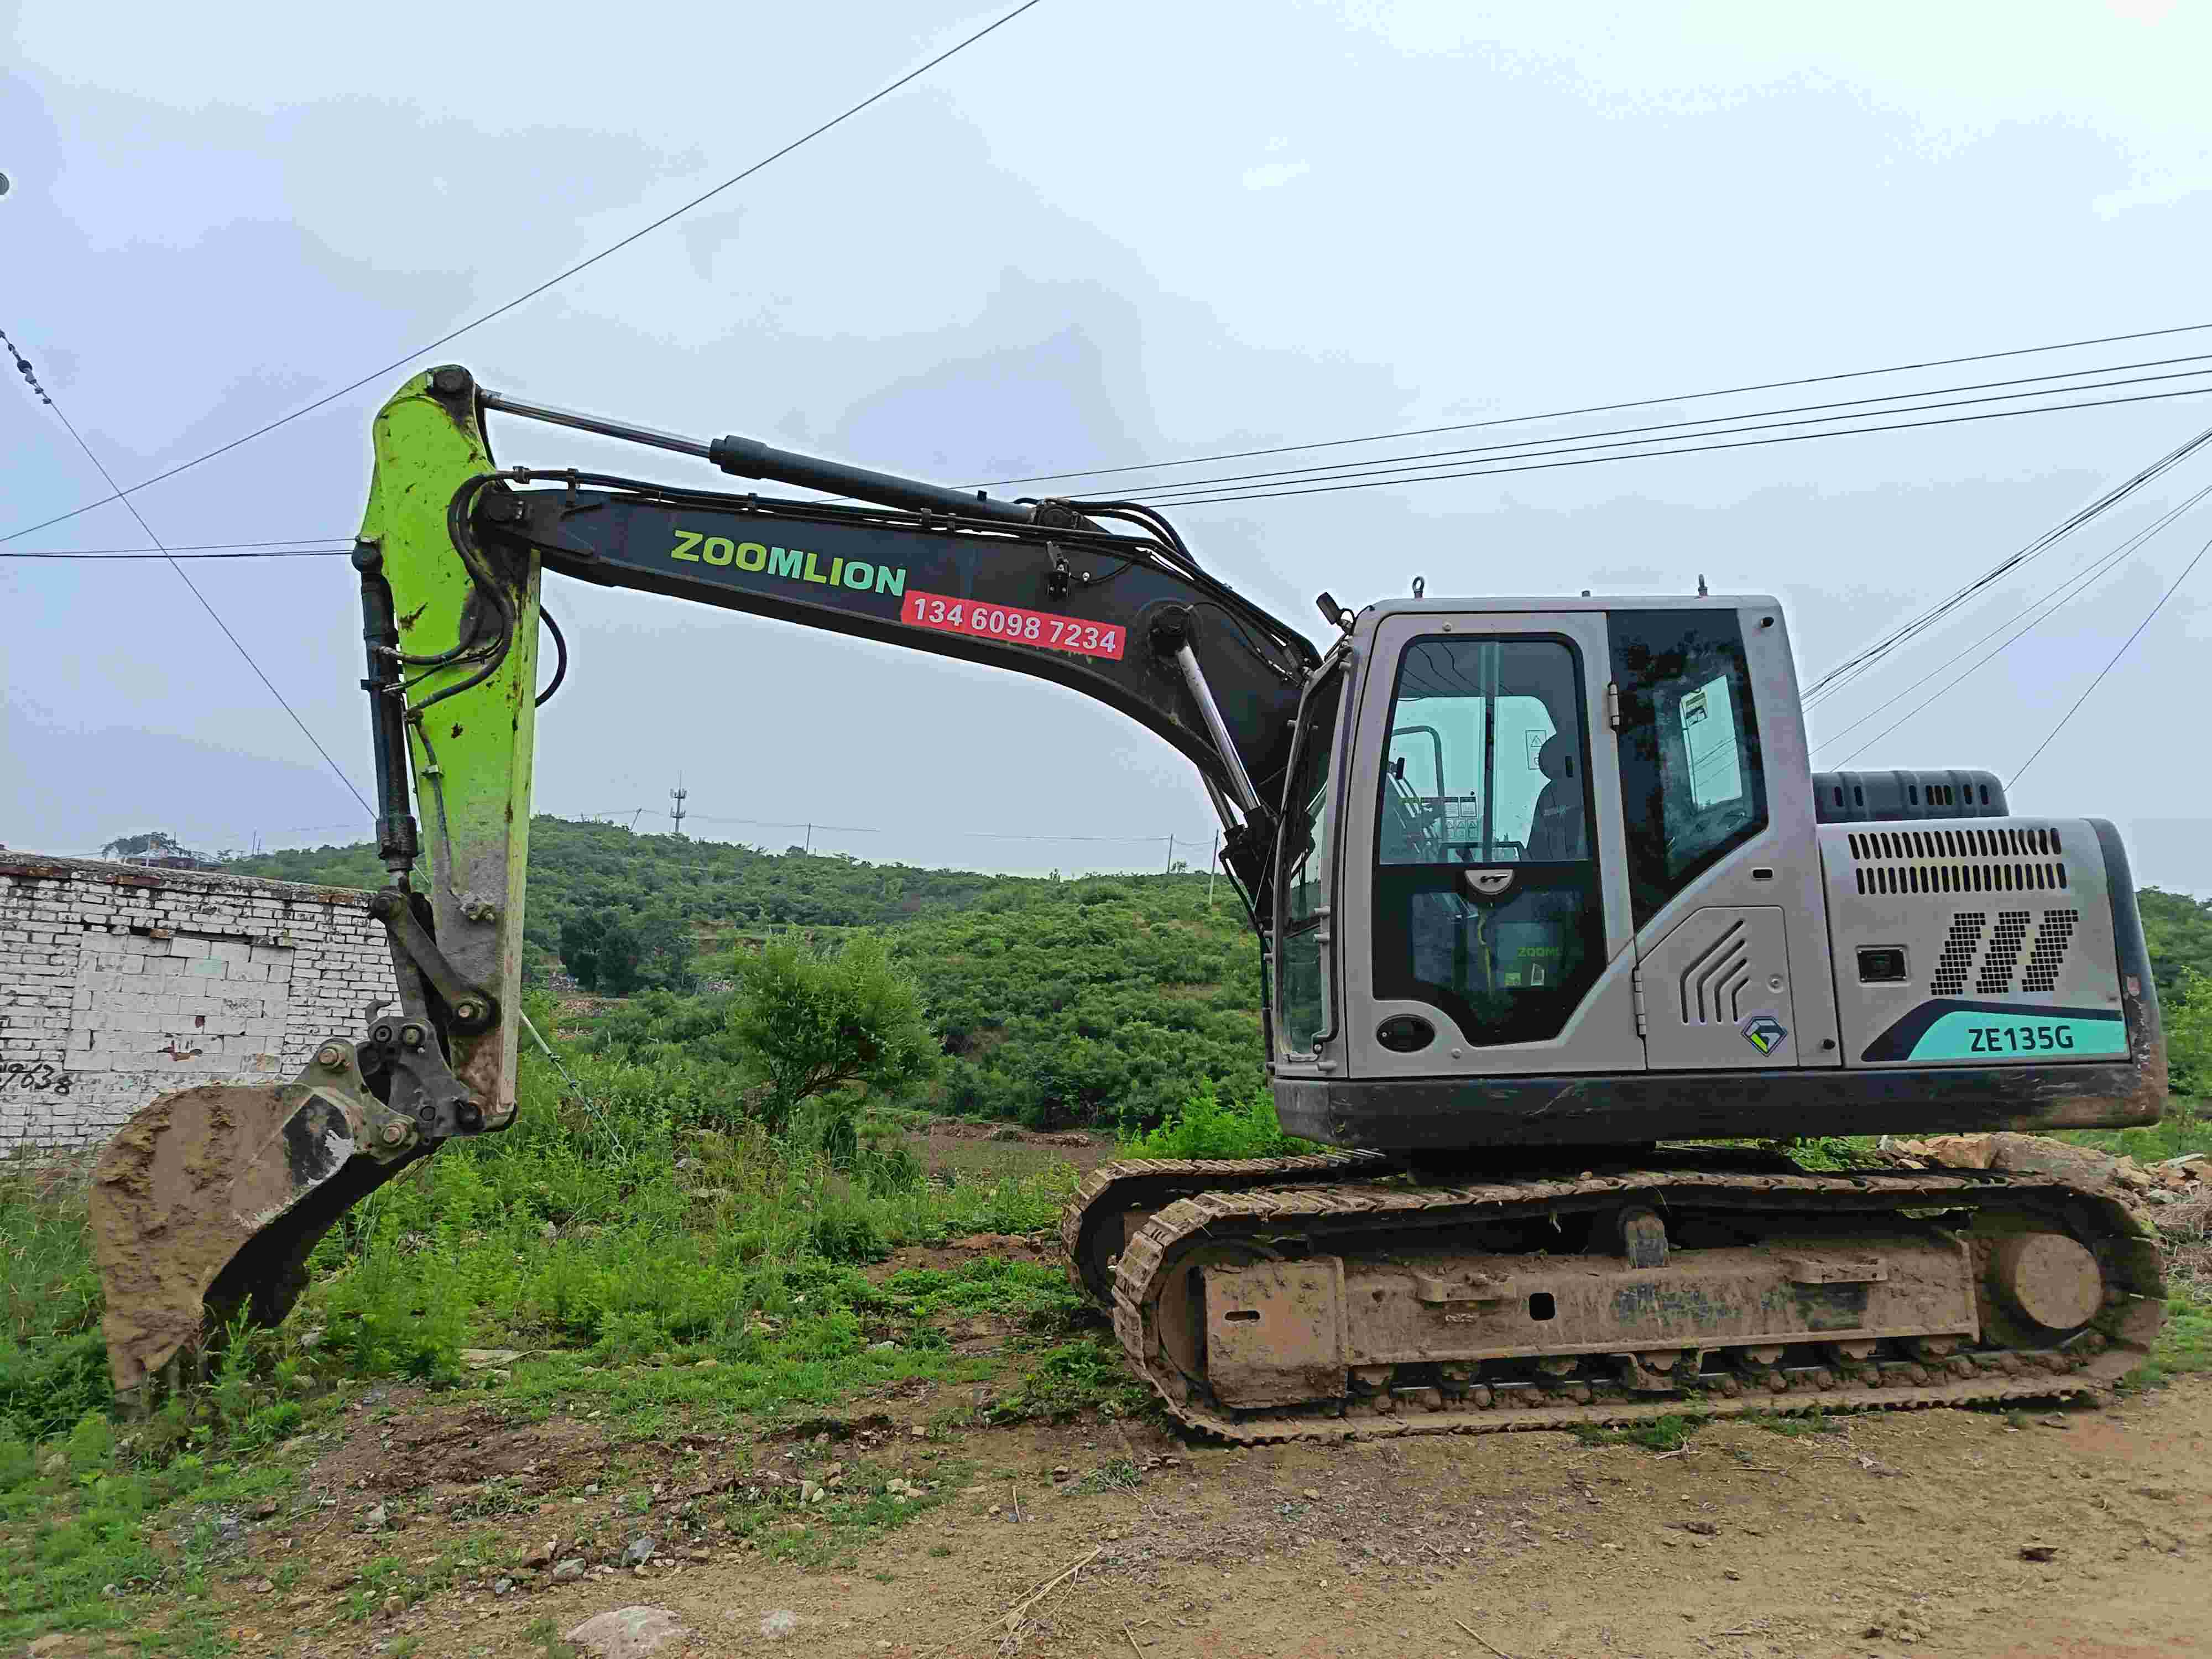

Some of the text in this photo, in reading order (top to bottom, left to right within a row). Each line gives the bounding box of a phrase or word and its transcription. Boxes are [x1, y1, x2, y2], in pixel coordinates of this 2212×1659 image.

[671, 530, 906, 597] ZOOMLION
[915, 598, 1115, 653] 134 6098 7234
[1968, 1025, 2073, 1052] ZE135G
